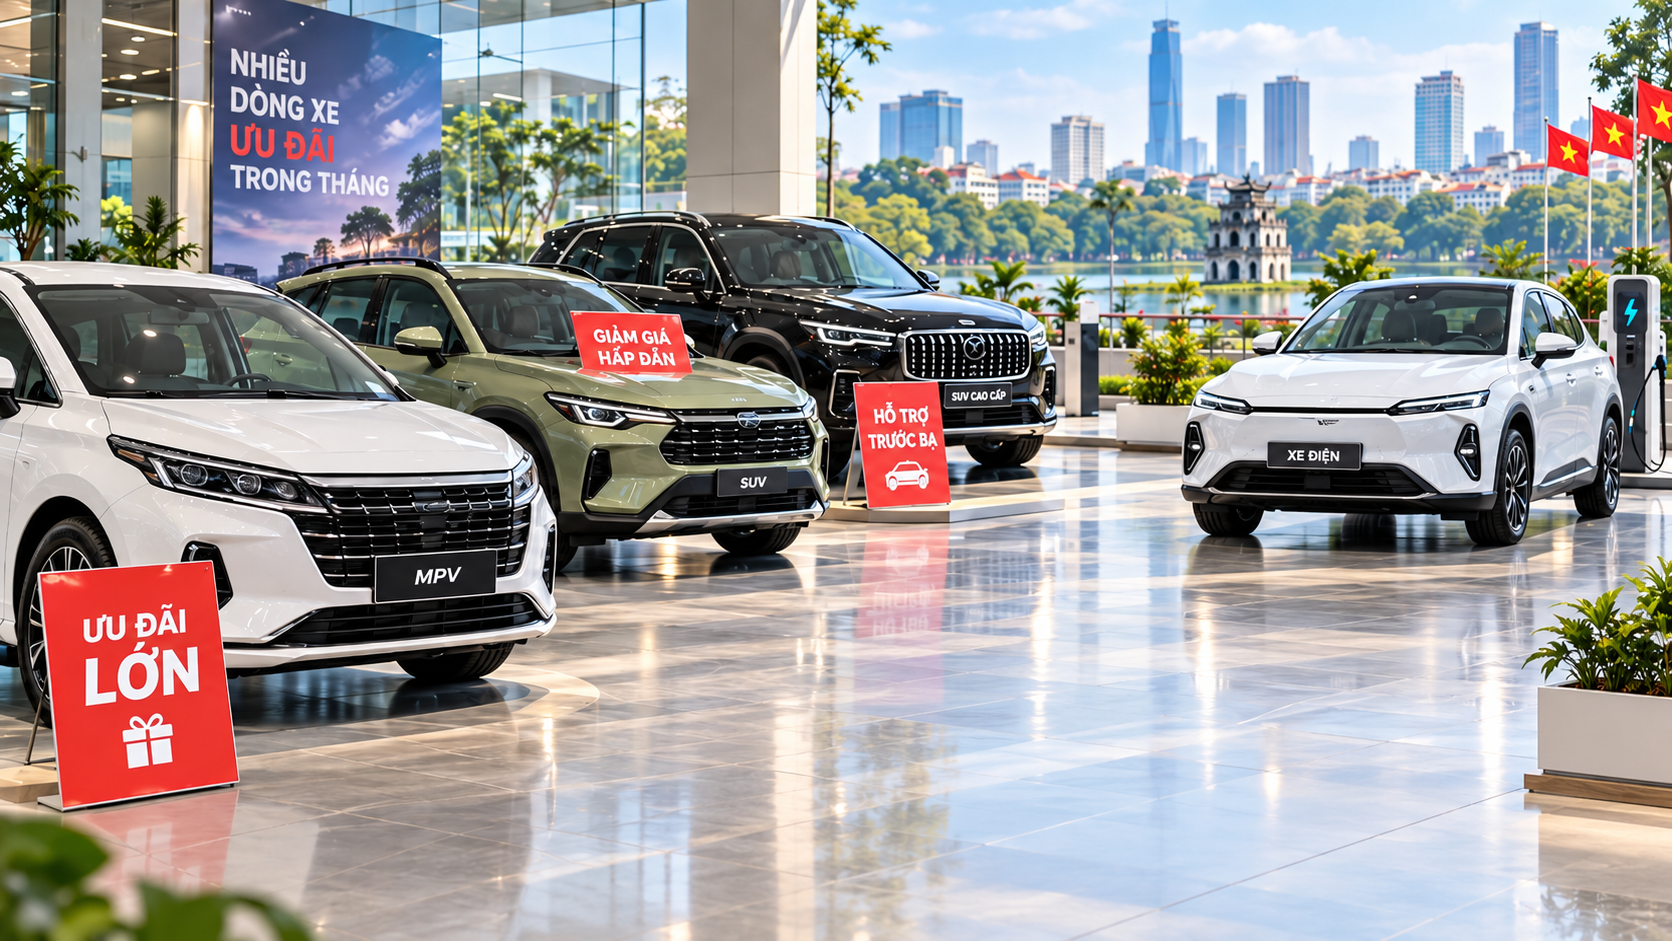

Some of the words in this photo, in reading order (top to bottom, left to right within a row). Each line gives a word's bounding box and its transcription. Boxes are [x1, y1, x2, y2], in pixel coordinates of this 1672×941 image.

[231, 48, 306, 86] NHIỀU
[231, 83, 304, 121] DÒNG
[311, 98, 339, 125] XE
[230, 122, 275, 158] ƯU
[284, 127, 334, 163] ĐÃI
[230, 164, 312, 193] TRONG
[317, 167, 389, 197] THÁNG
[593, 324, 639, 344] GIẢM
[641, 327, 672, 345] GIÁ
[951, 391, 969, 402] SUV
[970, 391, 988, 401] CAO
[873, 401, 897, 424] HỖ
[899, 405, 929, 427] TRỢ
[867, 429, 917, 450] TRƯỚC
[918, 431, 938, 451] BẠ
[1287, 449, 1305, 461] XE
[1307, 447, 1340, 464] ĐIỆN
[740, 476, 767, 489] SUV
[414, 566, 462, 586] MPV
[83, 614, 126, 643] ƯU
[134, 603, 186, 638] ĐÃI
[85, 641, 200, 706] LỚN
